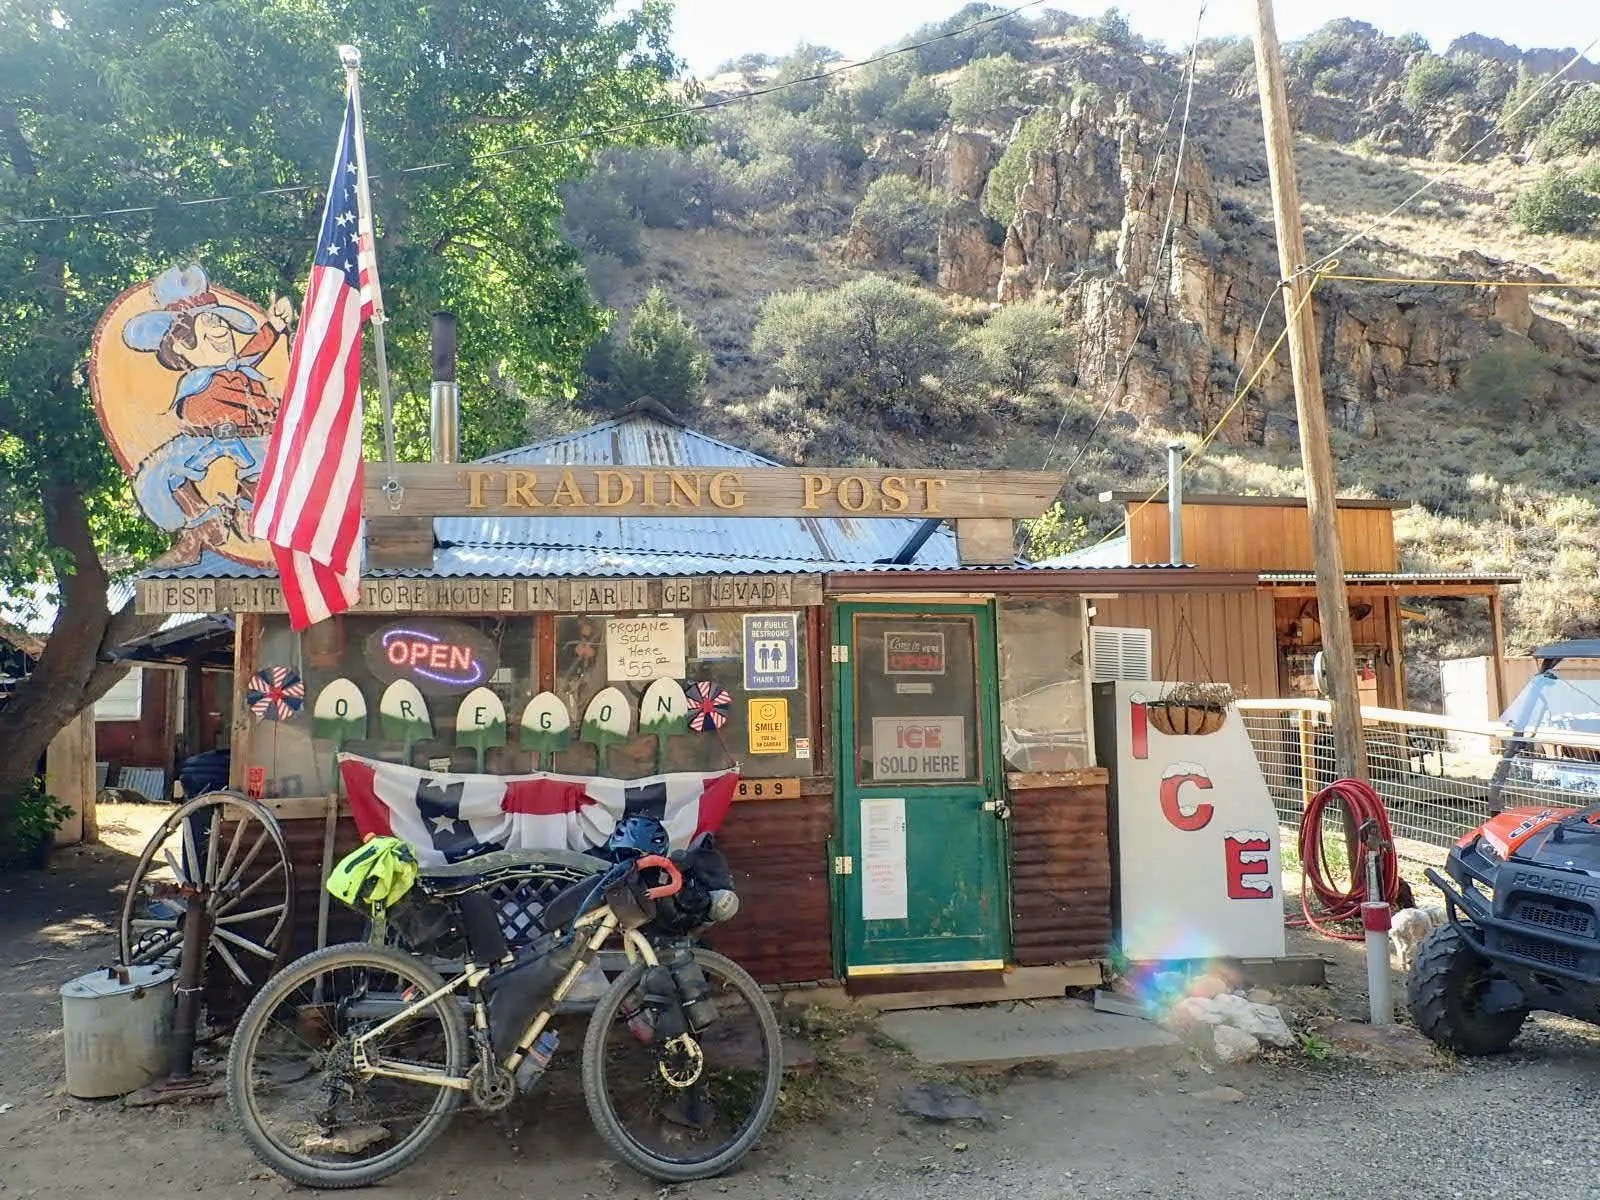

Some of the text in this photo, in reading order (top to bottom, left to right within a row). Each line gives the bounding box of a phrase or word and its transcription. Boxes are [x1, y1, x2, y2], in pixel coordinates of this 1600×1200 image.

[461, 469, 946, 514] TRADING POST
[148, 586, 213, 606] EST
[355, 585, 424, 606] TORE
[532, 586, 555, 605] IN
[751, 630, 790, 638] RESTROOMS
[752, 621, 788, 629] NO PUBLIC
[388, 640, 472, 670] OPEN
[776, 675, 790, 683] YOU
[755, 722, 782, 731] SMILE!
[896, 725, 942, 749] ICE
[880, 755, 960, 774] SOLD HERE
